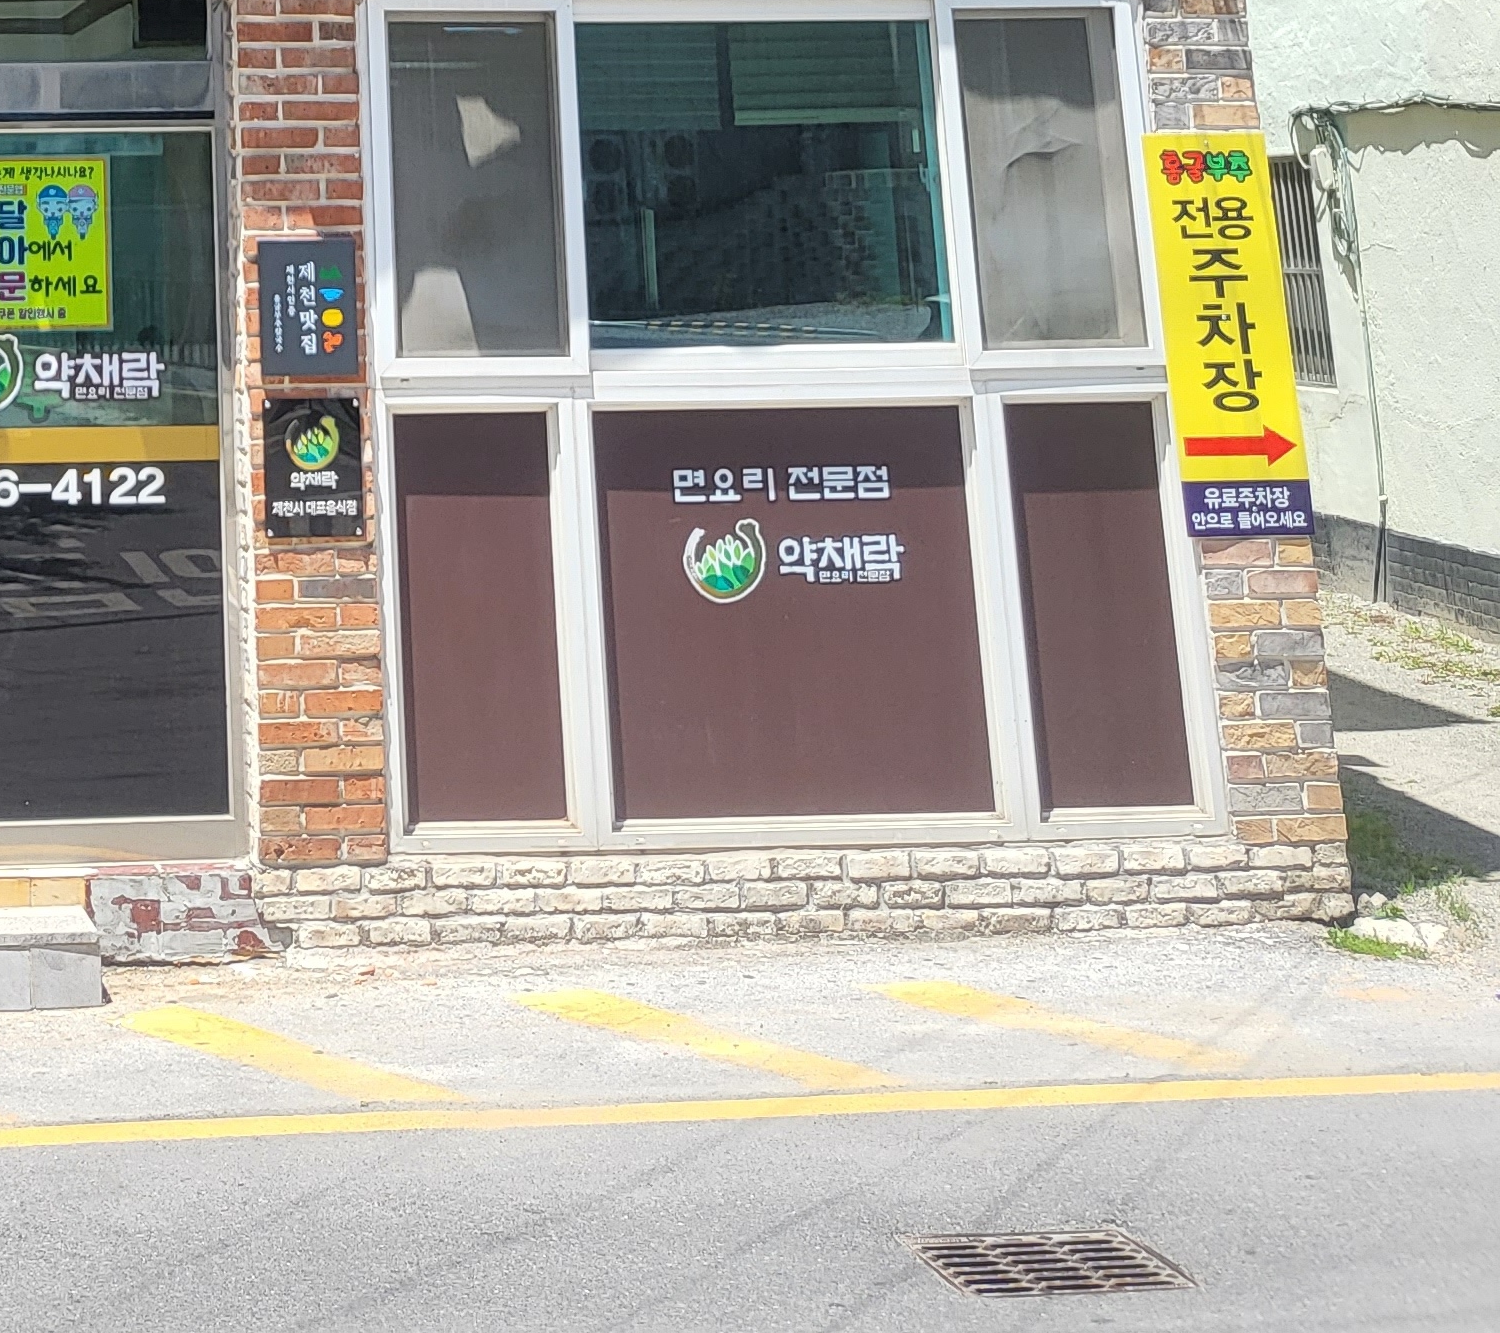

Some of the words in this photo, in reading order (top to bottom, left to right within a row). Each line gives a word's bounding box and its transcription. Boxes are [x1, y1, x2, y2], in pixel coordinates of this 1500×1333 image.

[19, 166, 95, 182] 생각나시나요?
[1171, 196, 1255, 241] 전용
[298, 260, 319, 356] 제천맛집
[1188, 247, 1263, 413] 주차장
[34, 351, 165, 399] 약채락
[290, 470, 339, 491] 약채락
[672, 468, 777, 503] 면요리
[787, 465, 891, 501] 전문점
[1203, 486, 1291, 510] 유료주차장
[271, 500, 304, 517] 제천시
[305, 499, 358, 516] 대표음식점
[1191, 511, 1235, 530] 안으로
[1237, 510, 1308, 530] 들어오세요
[778, 534, 905, 583] 약채락
